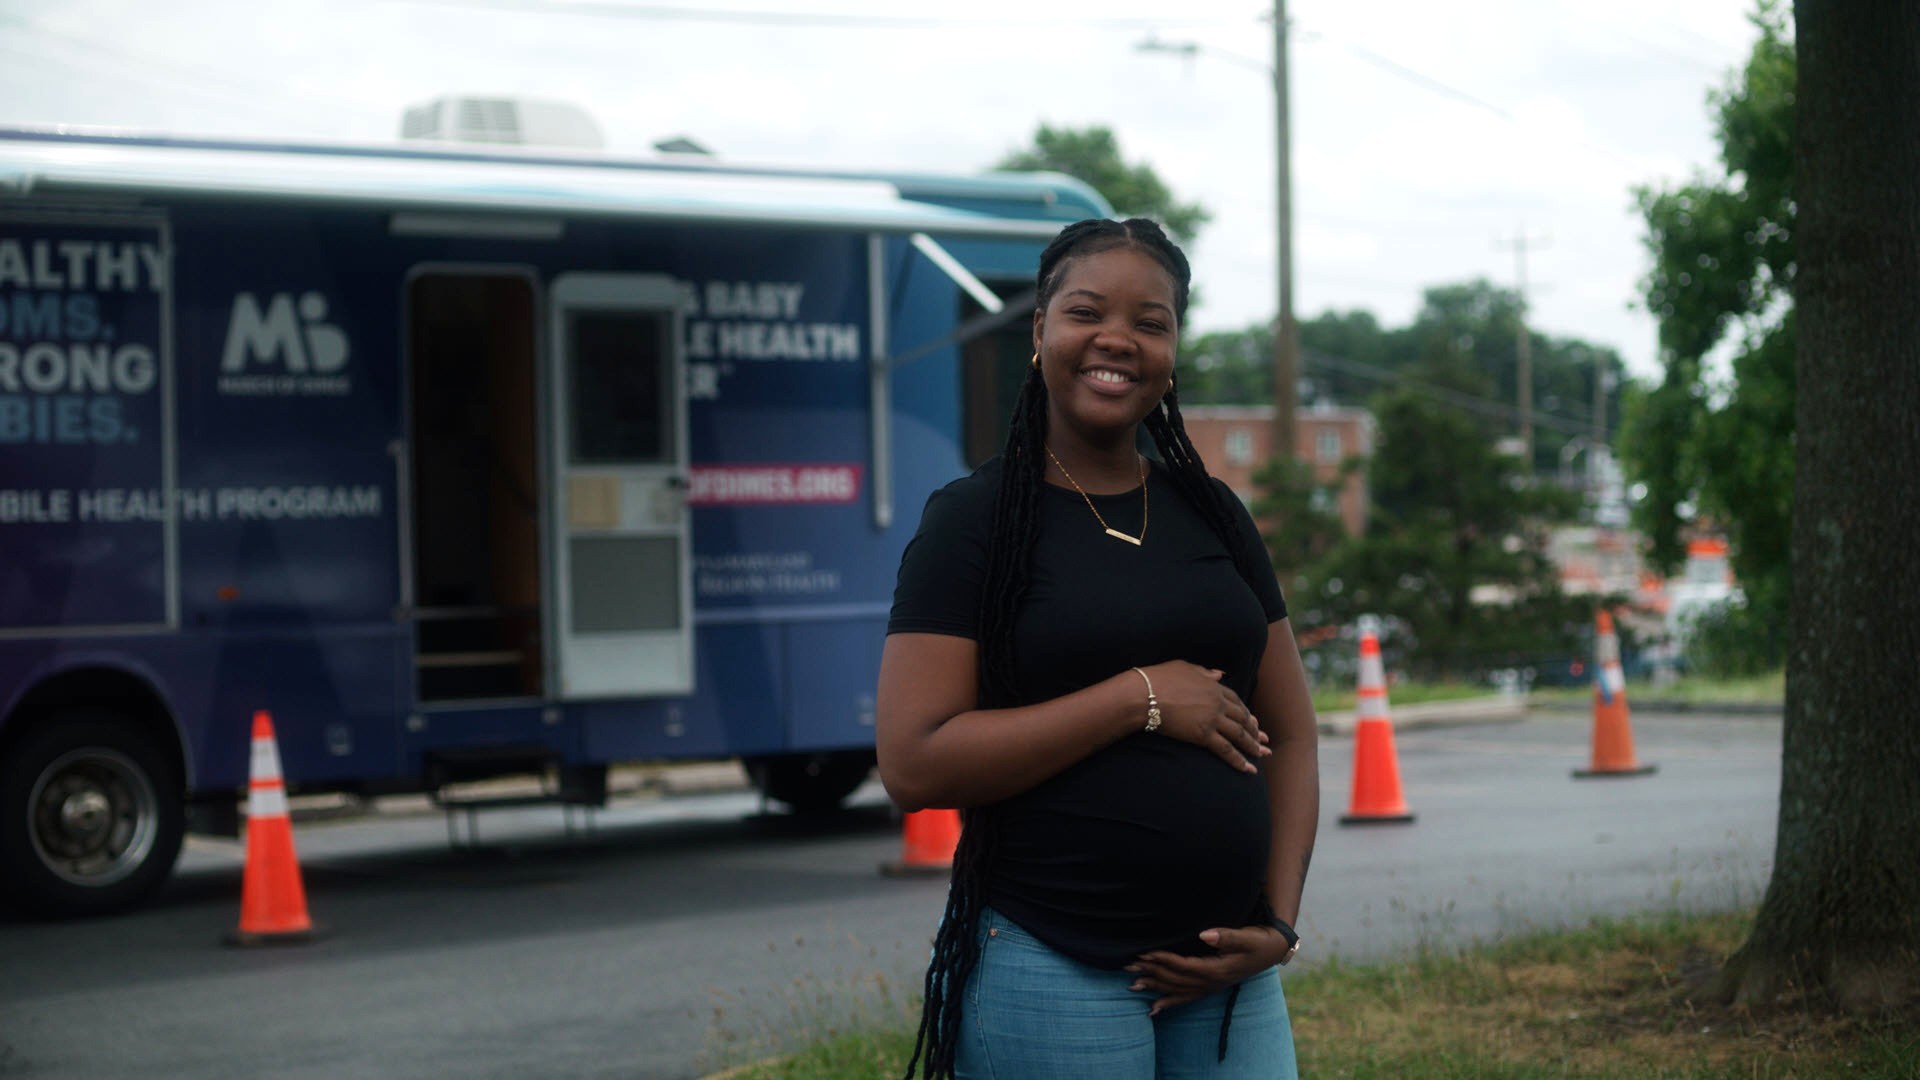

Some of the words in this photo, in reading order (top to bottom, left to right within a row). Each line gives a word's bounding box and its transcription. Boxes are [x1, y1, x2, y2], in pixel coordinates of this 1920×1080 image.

[0, 294, 115, 341] MS.
[706, 282, 803, 320] BABY
[718, 323, 860, 362] HEALTH
[79, 488, 210, 522] HEALTH
[217, 486, 381, 519] PROGRAM
